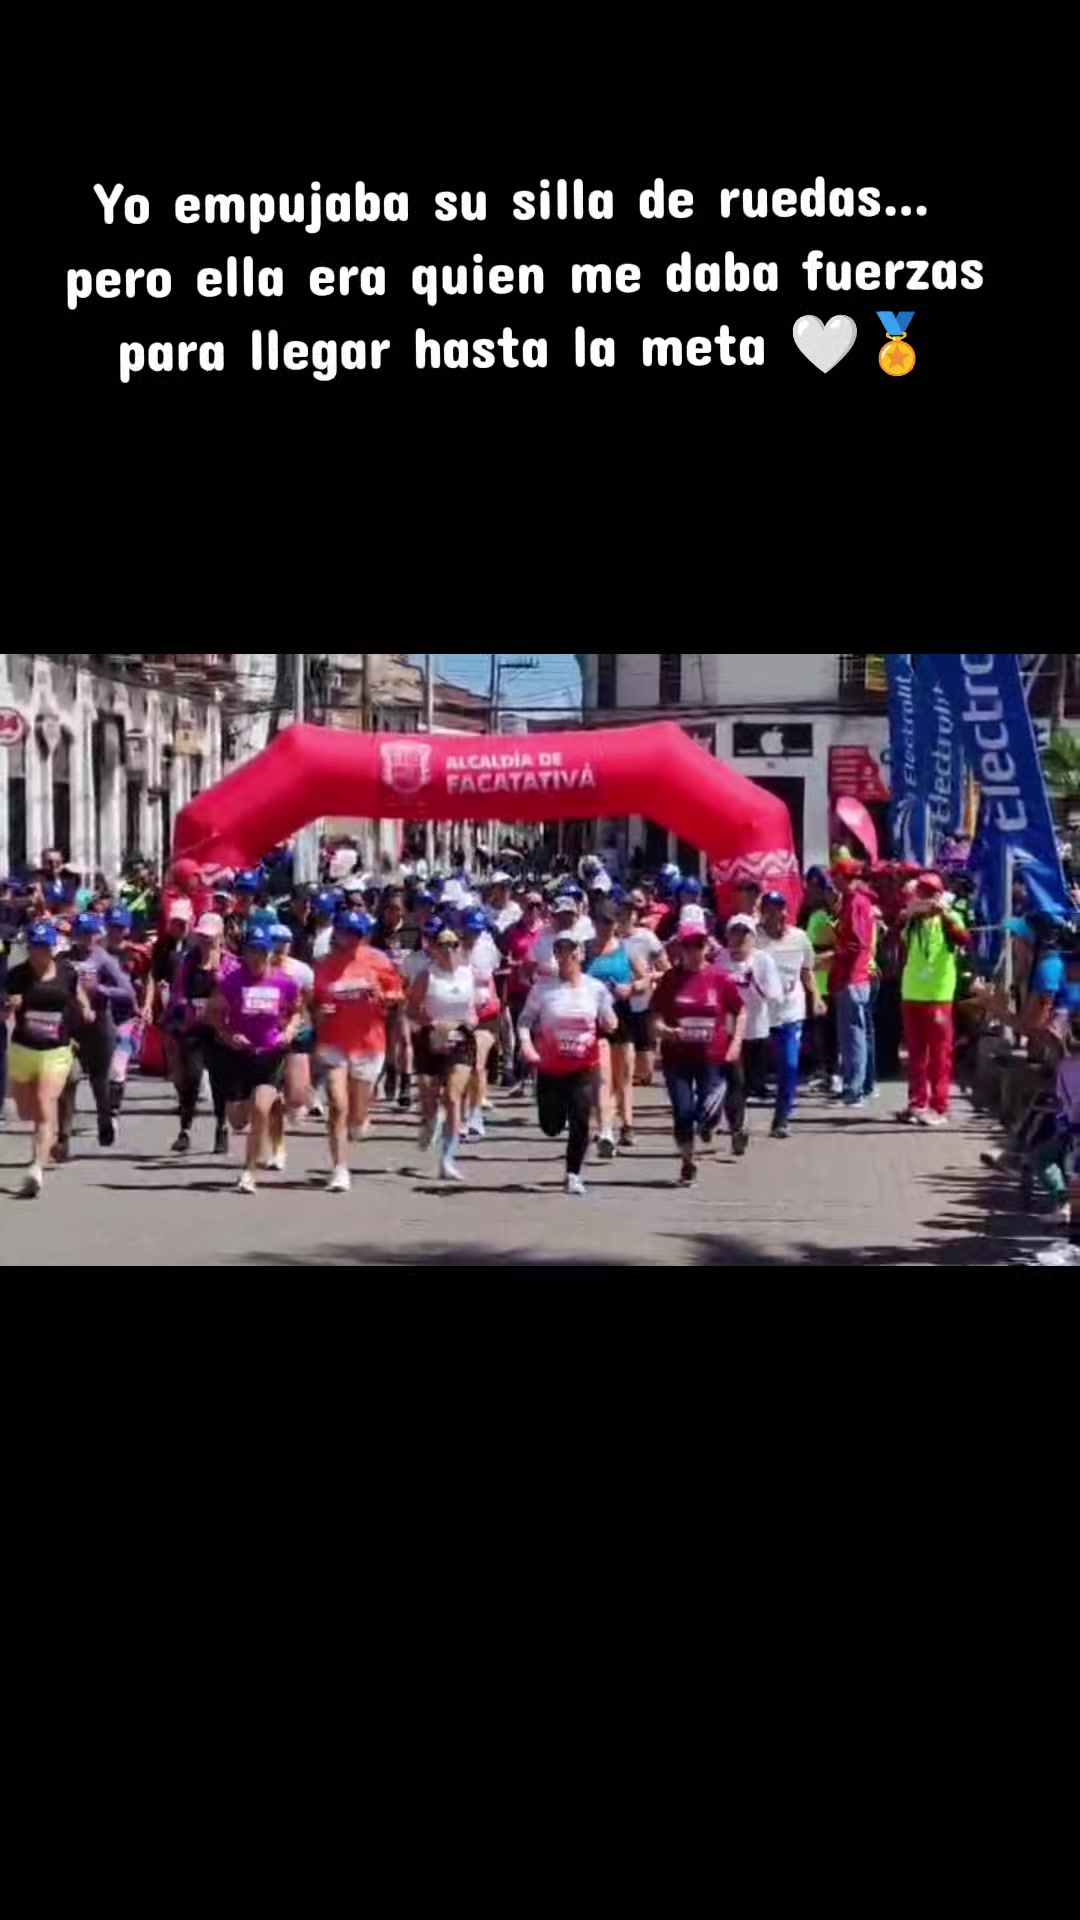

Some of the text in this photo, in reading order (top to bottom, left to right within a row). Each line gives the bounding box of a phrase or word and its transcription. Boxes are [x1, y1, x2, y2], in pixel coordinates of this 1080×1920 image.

[446, 751, 563, 770] ALCALDÍA DE
[445, 762, 597, 795] FACATATIVÁ
